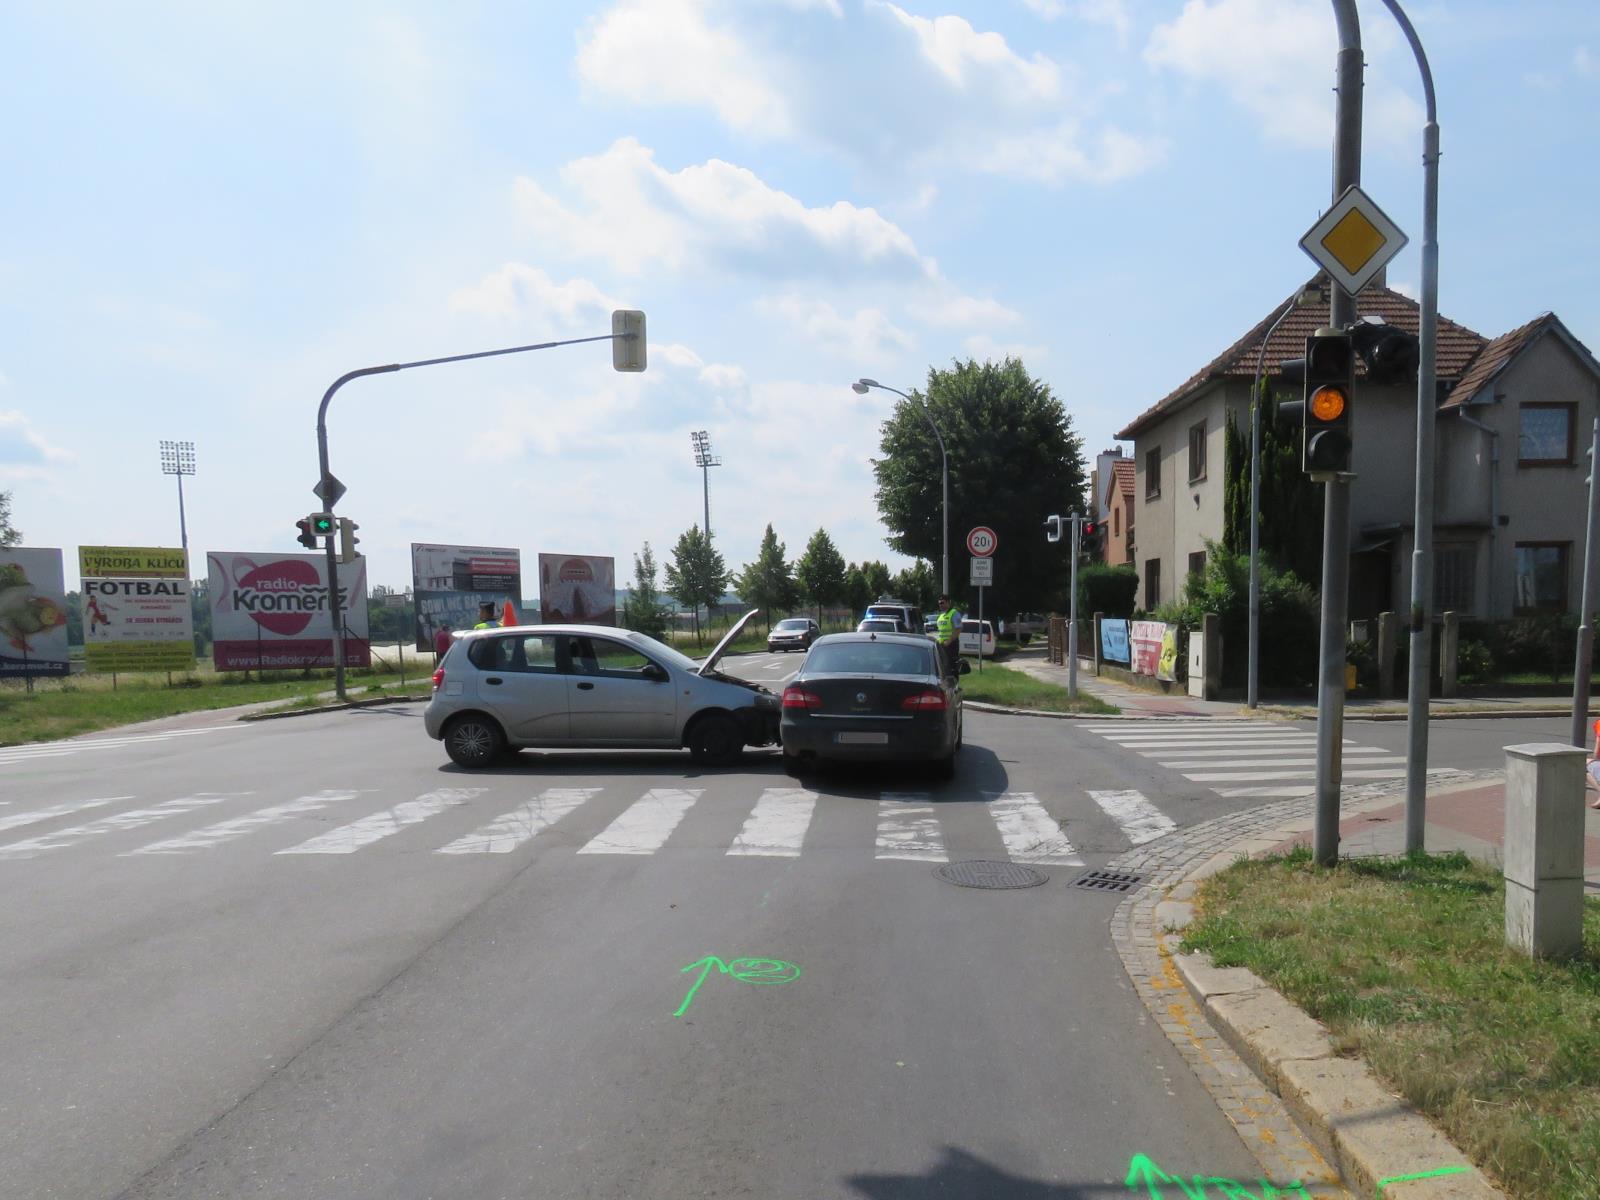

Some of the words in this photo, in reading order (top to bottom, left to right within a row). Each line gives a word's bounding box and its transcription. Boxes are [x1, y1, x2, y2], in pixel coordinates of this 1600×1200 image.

[85, 581, 186, 595] FOTBAL
[256, 578, 297, 590] radio
[233, 583, 348, 611] Kroměřž
